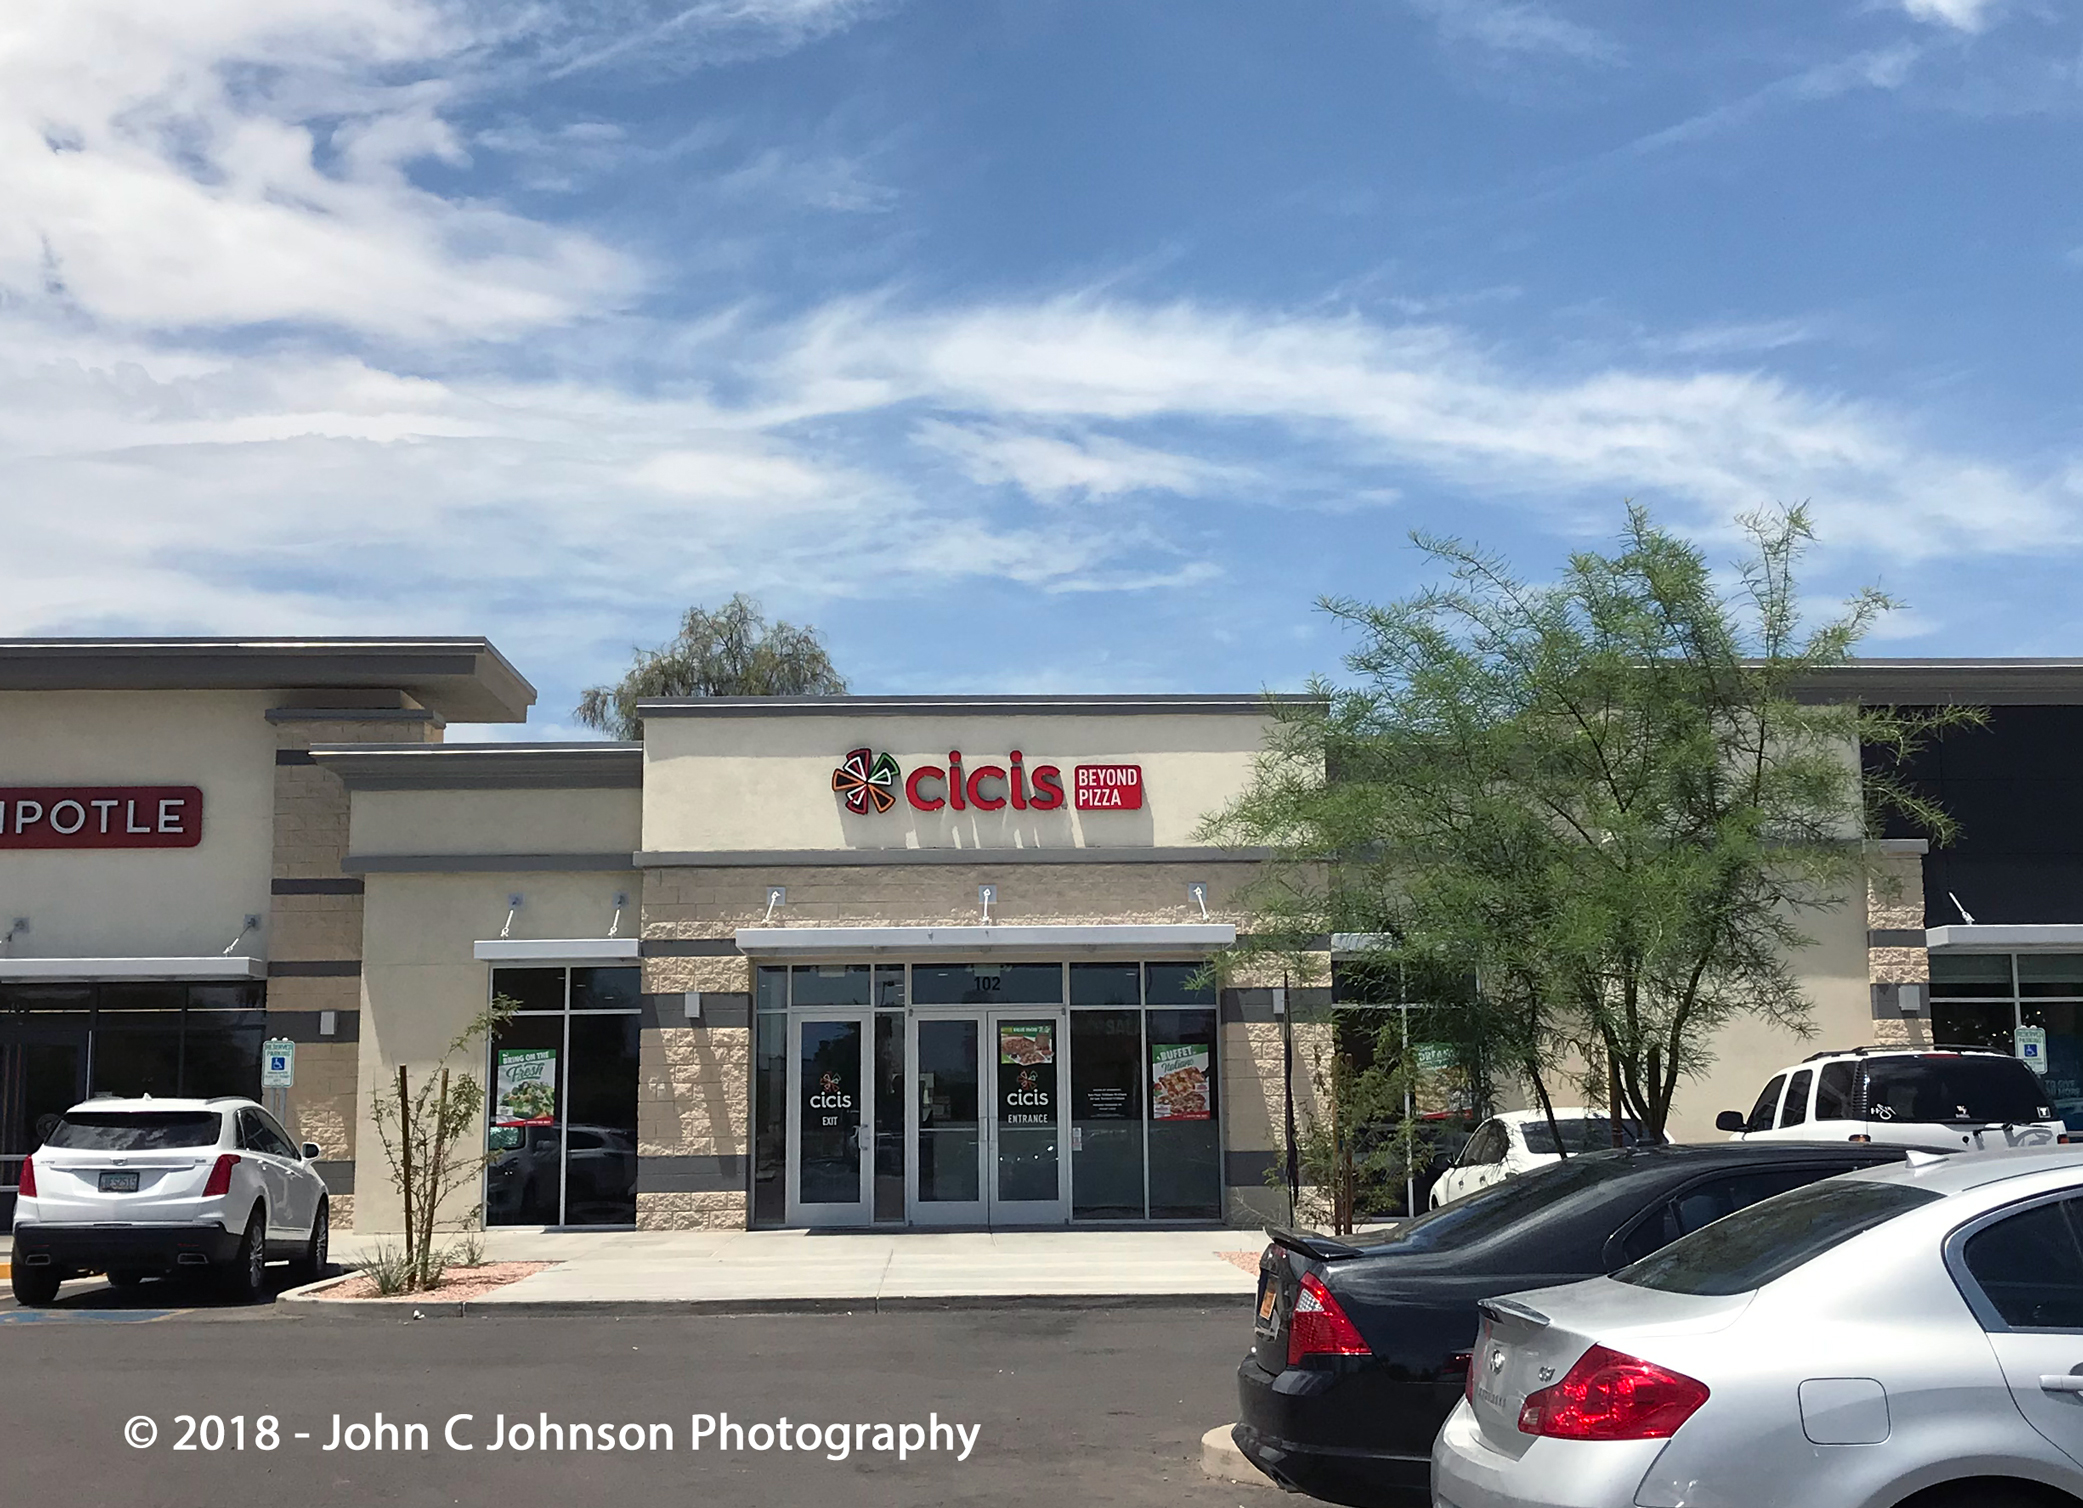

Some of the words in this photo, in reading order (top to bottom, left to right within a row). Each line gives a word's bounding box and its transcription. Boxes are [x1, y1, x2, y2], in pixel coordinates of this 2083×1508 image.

[905, 750, 1064, 811] cicis
[1078, 768, 1138, 787] BEYOND
[1079, 788, 1122, 806] PIZZA
[974, 976, 1001, 991] 102
[502, 1054, 525, 1065] BRING
[525, 1053, 536, 1061] ON
[536, 1050, 550, 1060] THE
[1160, 1046, 1193, 1061] BUFFET
[506, 1062, 545, 1082] Fresh
[810, 1091, 852, 1108] cicis
[1007, 1088, 1049, 1106] cicis
[822, 1116, 838, 1126] EXIT
[1008, 1114, 1048, 1123] ENTRANCE
